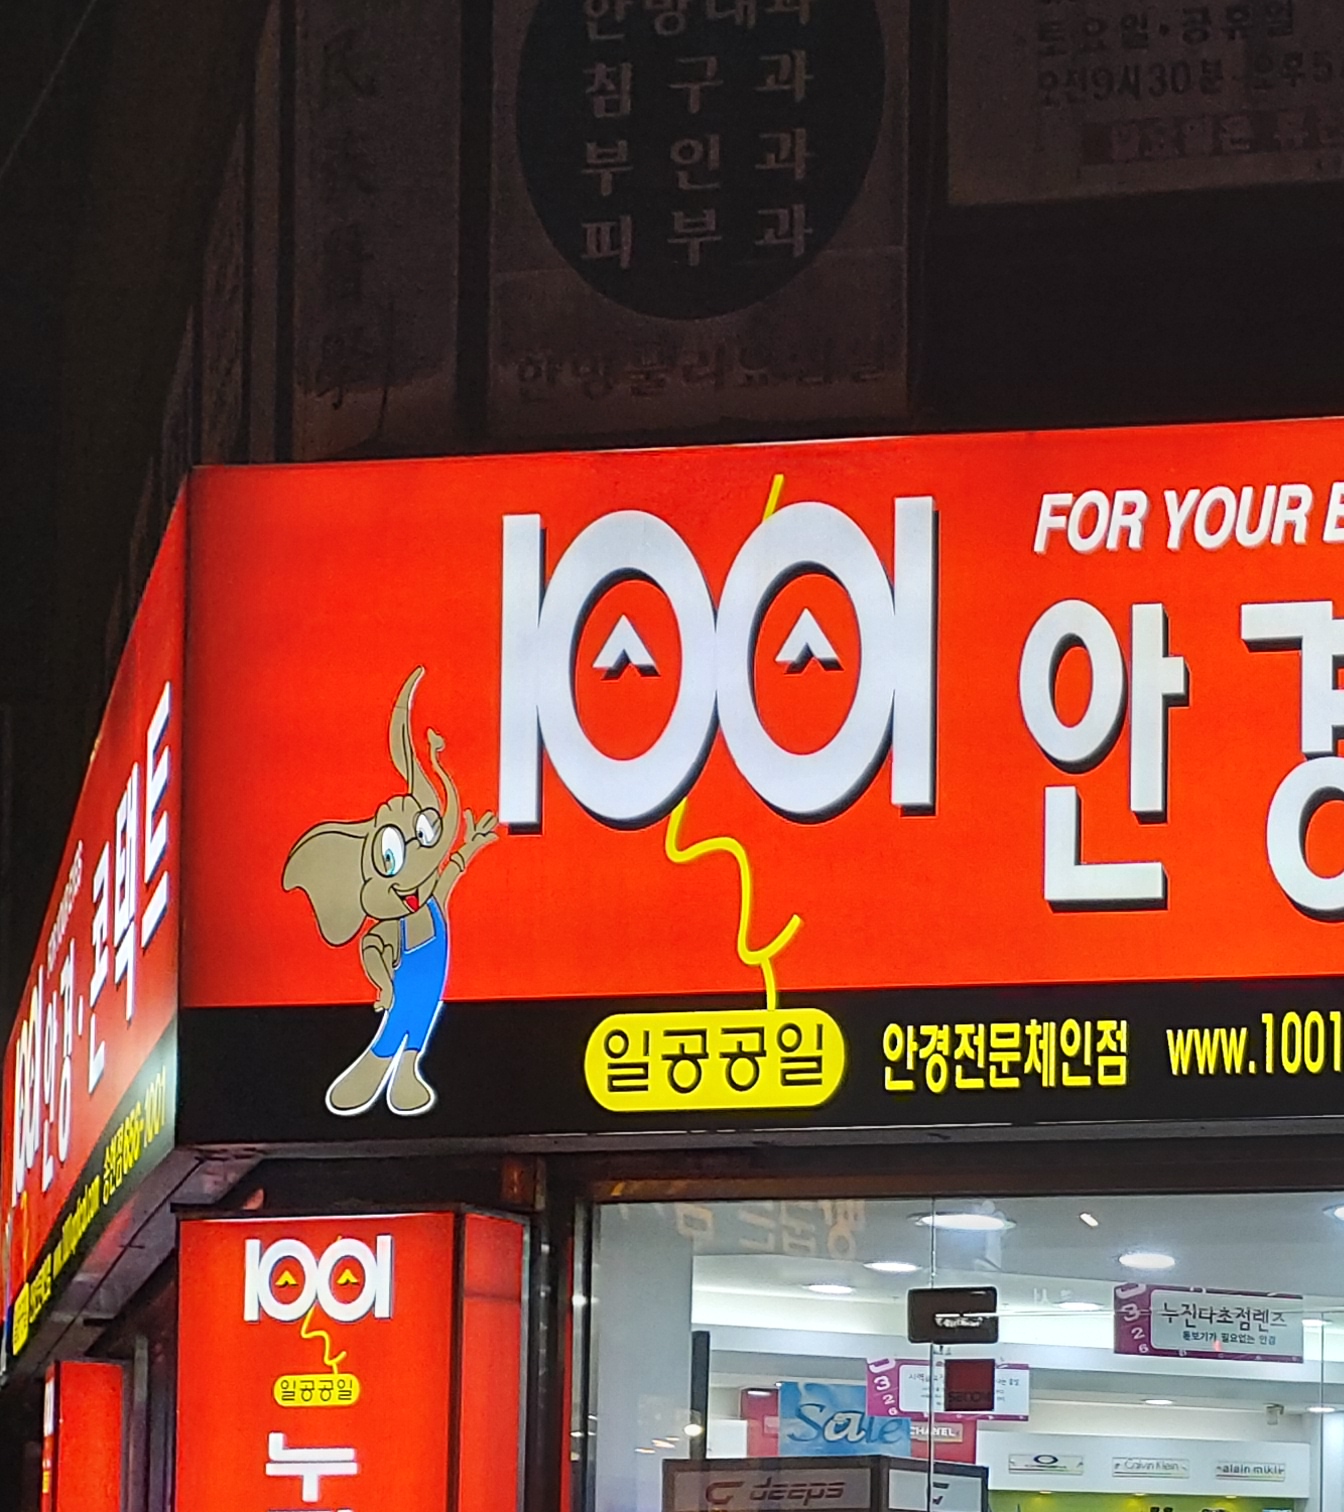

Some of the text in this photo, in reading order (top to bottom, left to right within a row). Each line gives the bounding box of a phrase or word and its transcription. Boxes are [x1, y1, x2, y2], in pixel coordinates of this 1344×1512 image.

[580, 203, 814, 270] 피부과
[1034, 489, 1149, 555] FOR
[1162, 482, 1313, 552] YOUR
[499, 496, 937, 828] 1001
[603, 1018, 827, 1093] 일공공일
[883, 1019, 1126, 1093] 안경전문체인점
[244, 1235, 394, 1321] 1001
[1161, 1302, 1287, 1333] 누진다초점렌즈
[279, 1376, 355, 1404] 일공공일
[787, 1401, 905, 1445] Sale
[748, 1481, 846, 1506] deeps
